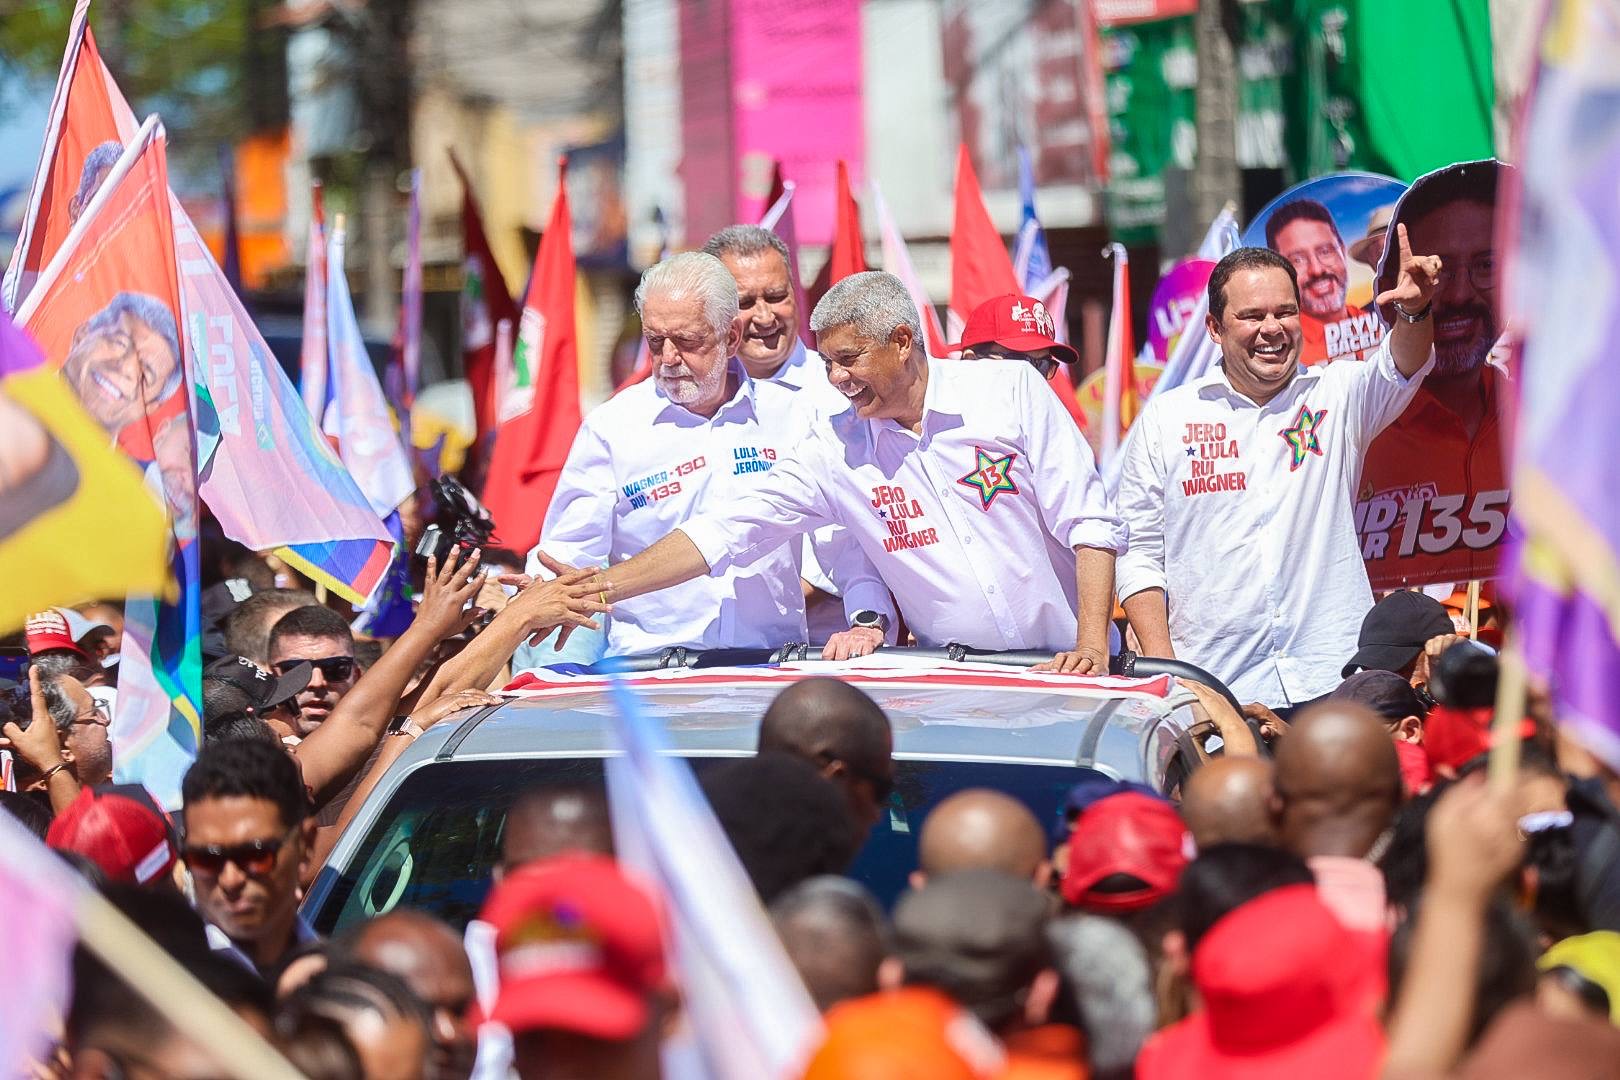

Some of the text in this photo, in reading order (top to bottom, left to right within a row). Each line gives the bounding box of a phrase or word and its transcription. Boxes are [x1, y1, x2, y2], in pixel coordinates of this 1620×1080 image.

[1182, 423, 1227, 444] JERO
[733, 447, 758, 460] LULA
[1200, 440, 1239, 460] LULA
[622, 455, 706, 498] WAGNER 130
[978, 465, 1003, 489] 13
[1191, 460, 1215, 478] RUI
[1182, 472, 1246, 496] WAGNER
[629, 481, 682, 510] RUI 133
[889, 499, 925, 520] LULA
[886, 519, 908, 536] RUI
[883, 527, 940, 553] WAGNER
